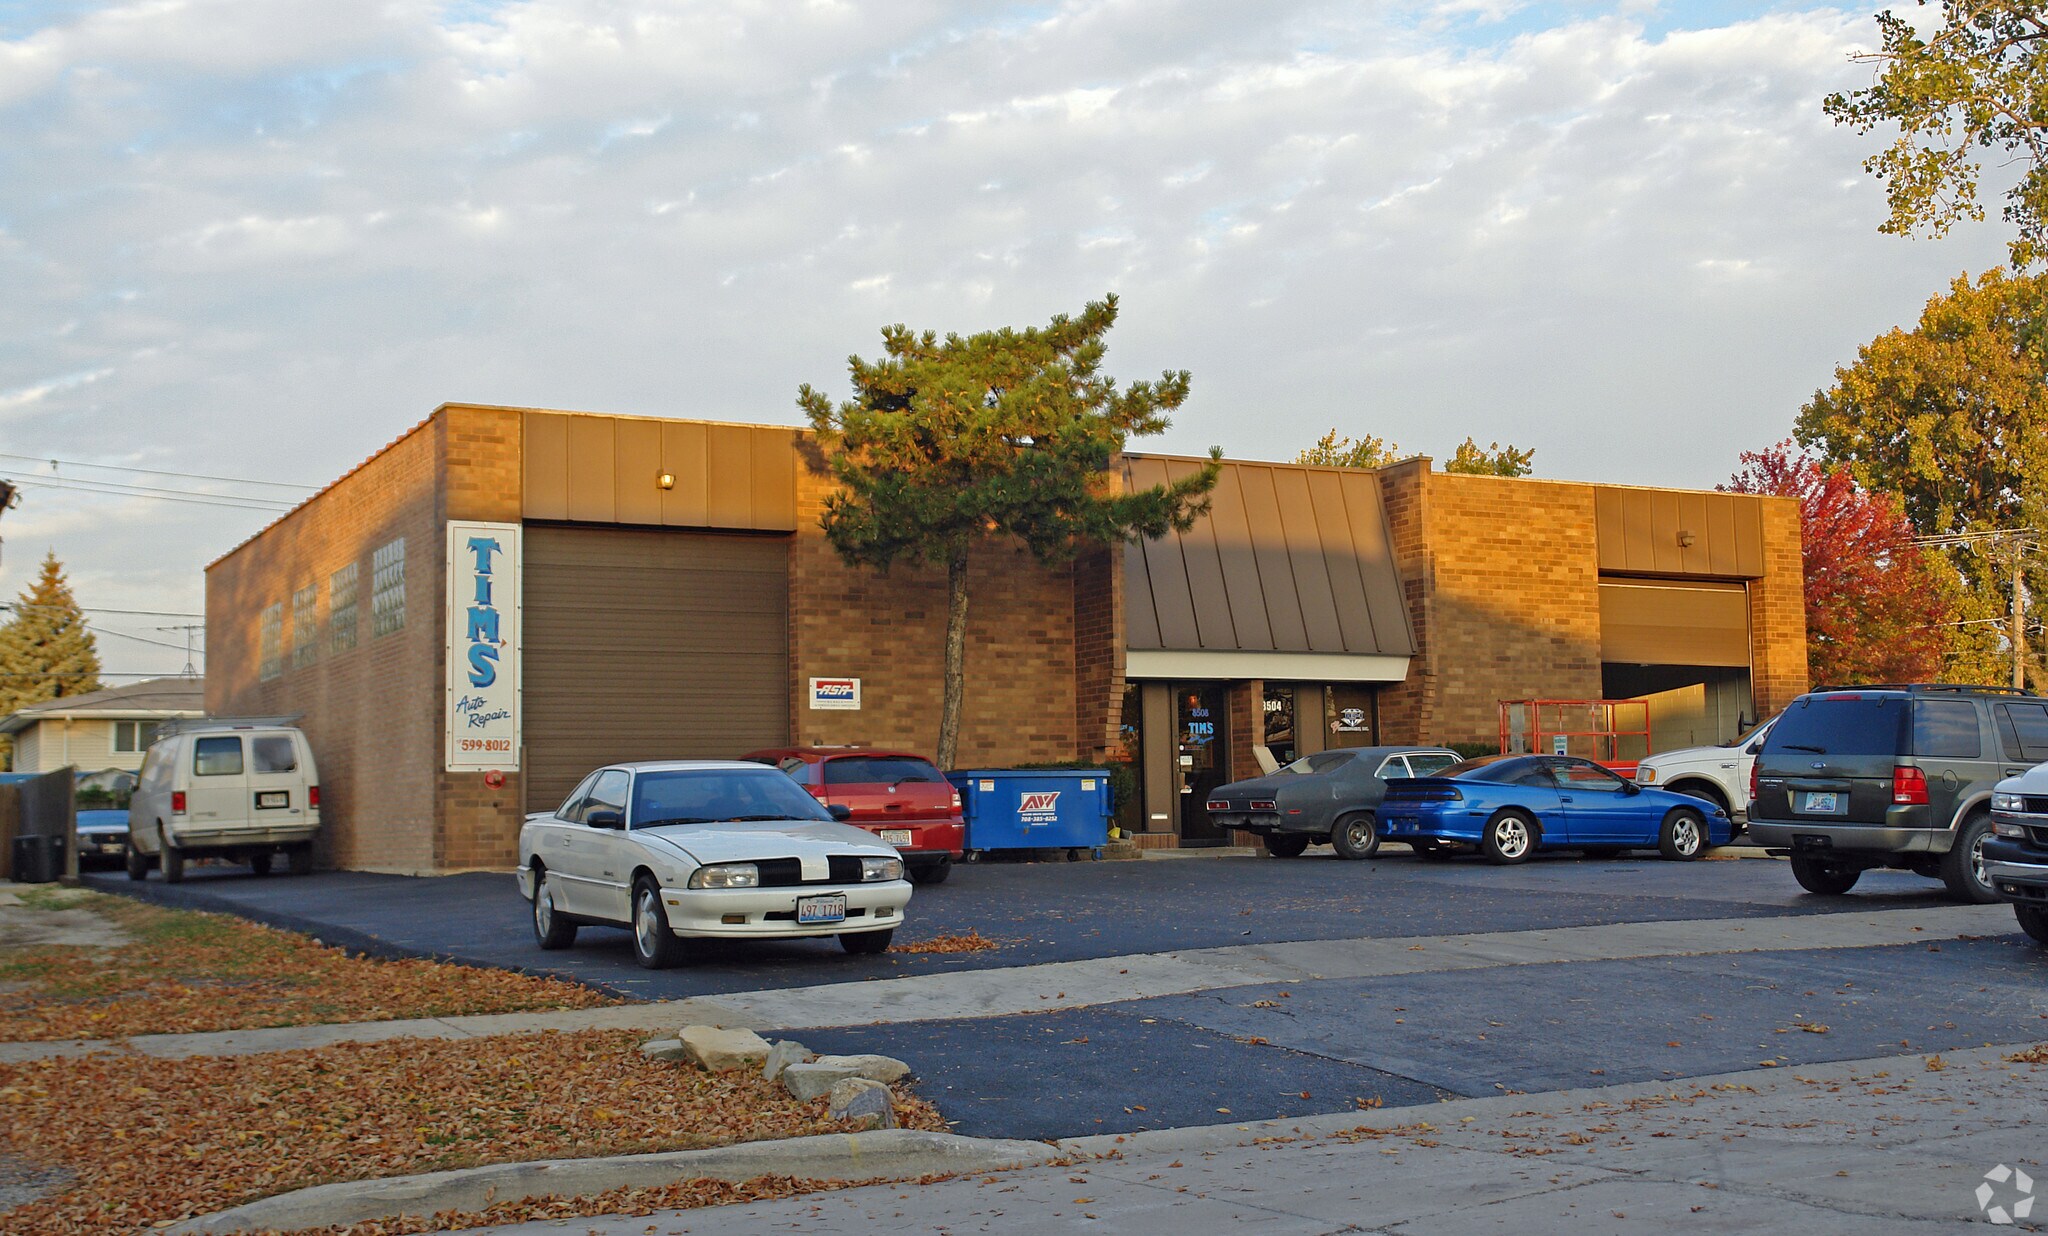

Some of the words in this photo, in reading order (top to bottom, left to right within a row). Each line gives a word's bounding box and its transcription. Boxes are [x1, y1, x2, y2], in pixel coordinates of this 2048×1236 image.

[456, 695, 487, 714] Auto
[468, 708, 511, 728] Repair
[1018, 792, 1060, 812] AW
[822, 904, 844, 916] 1718
